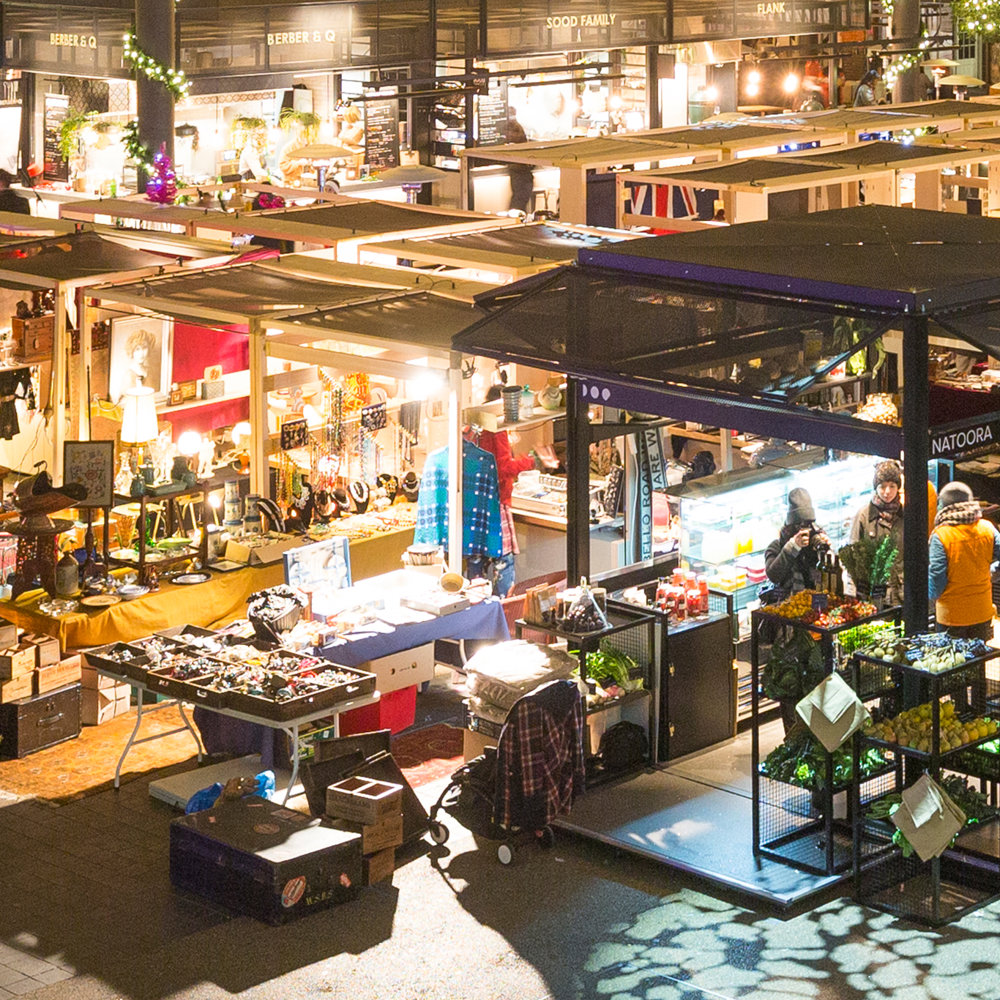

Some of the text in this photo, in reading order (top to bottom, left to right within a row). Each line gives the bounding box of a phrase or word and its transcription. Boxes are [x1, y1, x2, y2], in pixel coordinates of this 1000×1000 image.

[757, 2, 785, 15] FLANK
[546, 13, 616, 29] SOOD FAMILY
[50, 32, 98, 49] BERBER & Q
[267, 29, 336, 45] BERBER & Q
[932, 425, 993, 455] NATOORA
[641, 461, 651, 508] ROAD
